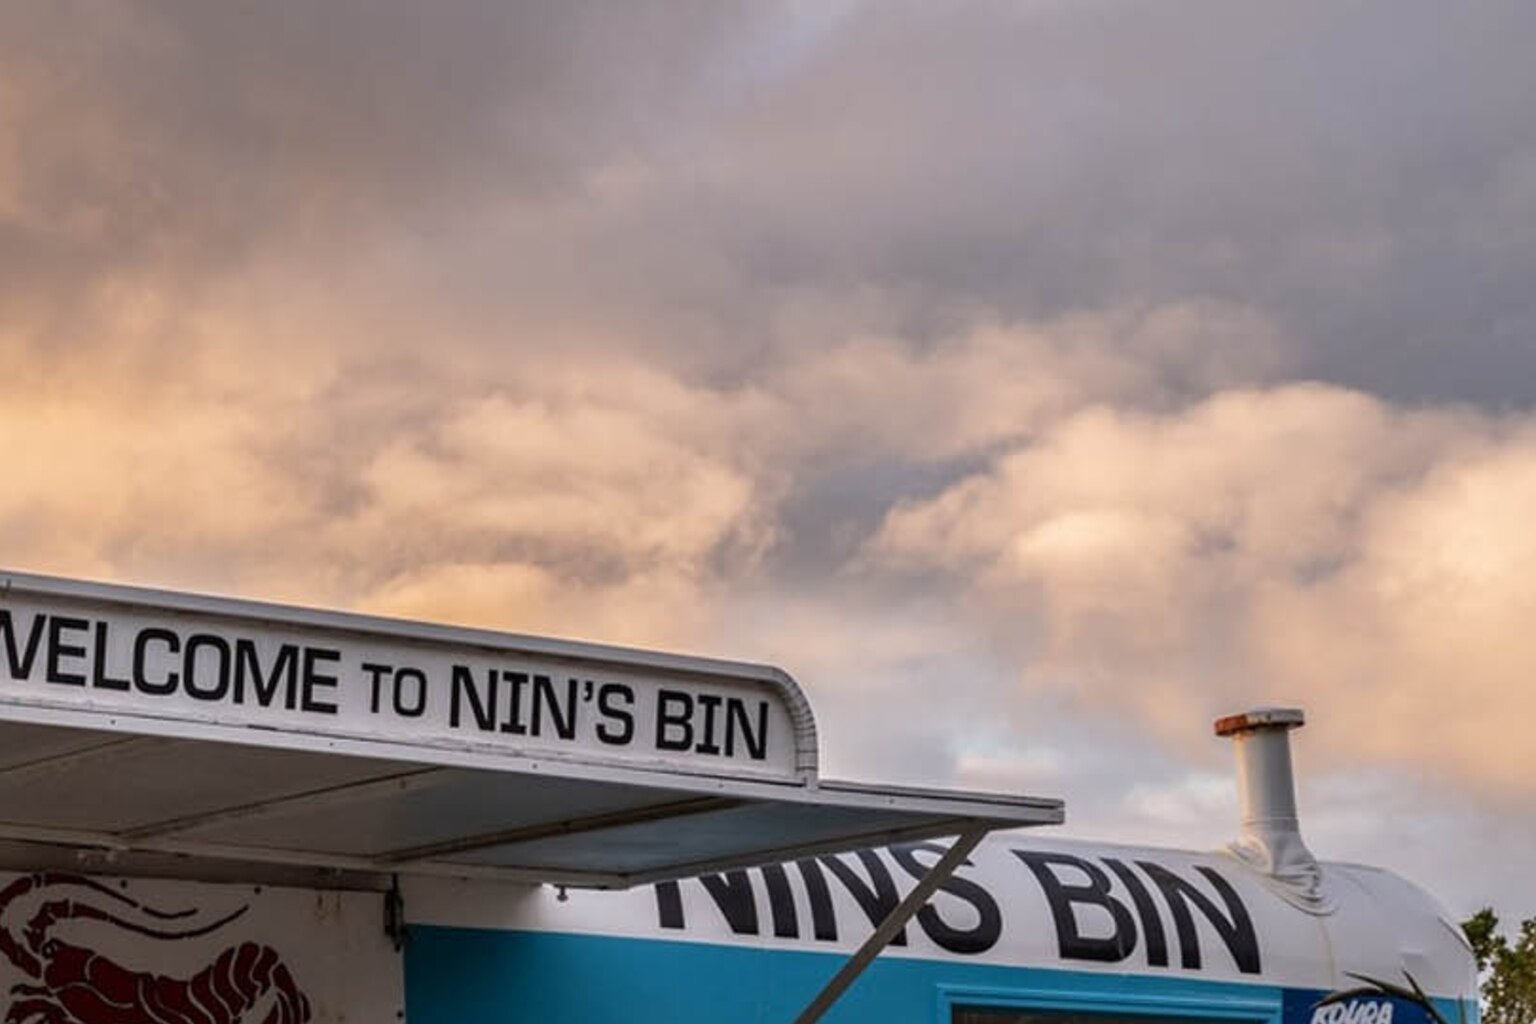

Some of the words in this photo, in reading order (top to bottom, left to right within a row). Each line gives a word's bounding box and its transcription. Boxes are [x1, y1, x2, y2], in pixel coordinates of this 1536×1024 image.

[361, 662, 429, 718] TO
[449, 664, 636, 746] NIN'S
[654, 688, 771, 761] BIN
[1016, 849, 1261, 975] BIN
